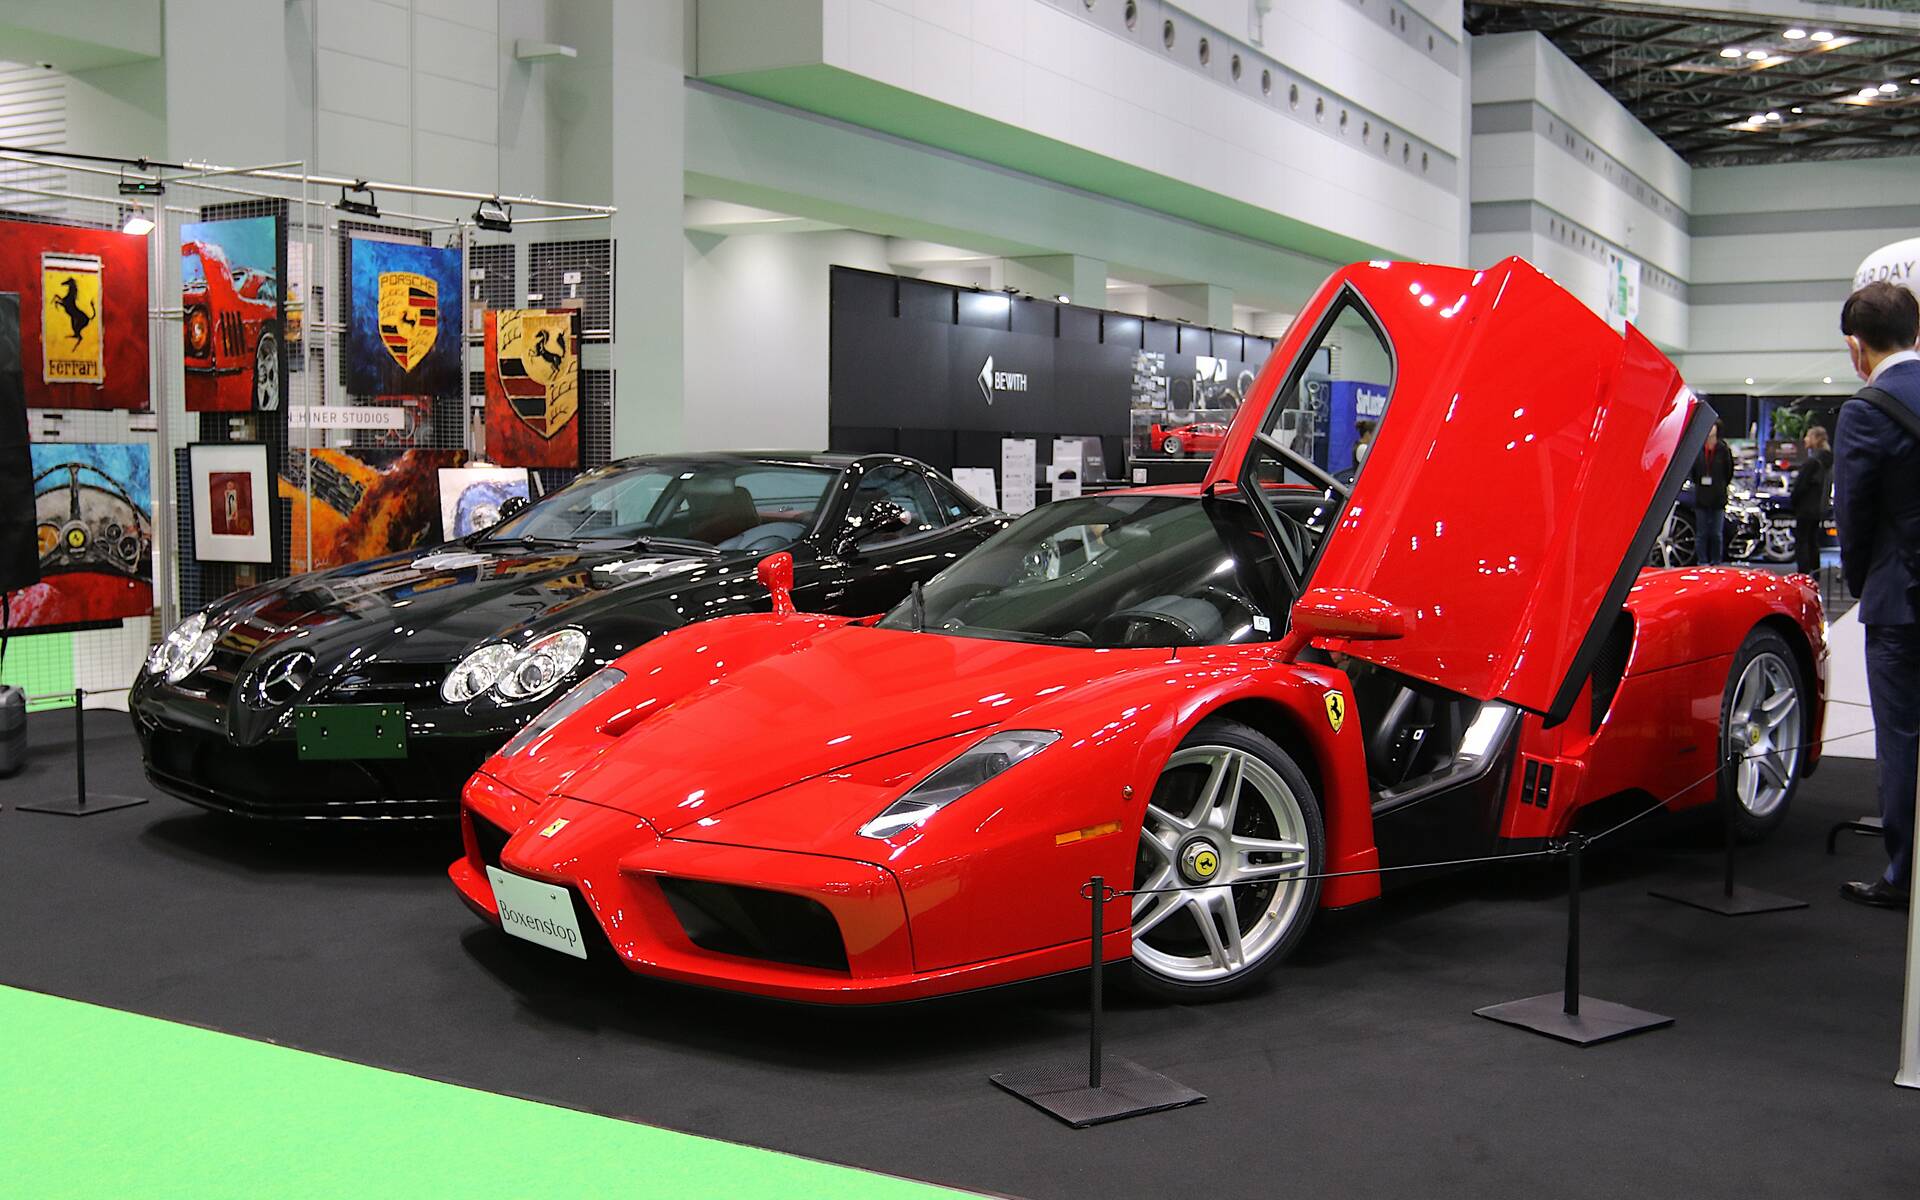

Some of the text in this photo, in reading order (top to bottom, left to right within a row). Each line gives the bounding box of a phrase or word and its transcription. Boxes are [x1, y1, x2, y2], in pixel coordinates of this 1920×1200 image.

[1878, 260, 1916, 282] DAY
[380, 274, 437, 292] PORSCHE
[994, 371, 1028, 392] BEWITH
[299, 411, 337, 424] HINER
[338, 412, 390, 424] STUDIOS
[499, 899, 577, 948] Boxenstop
